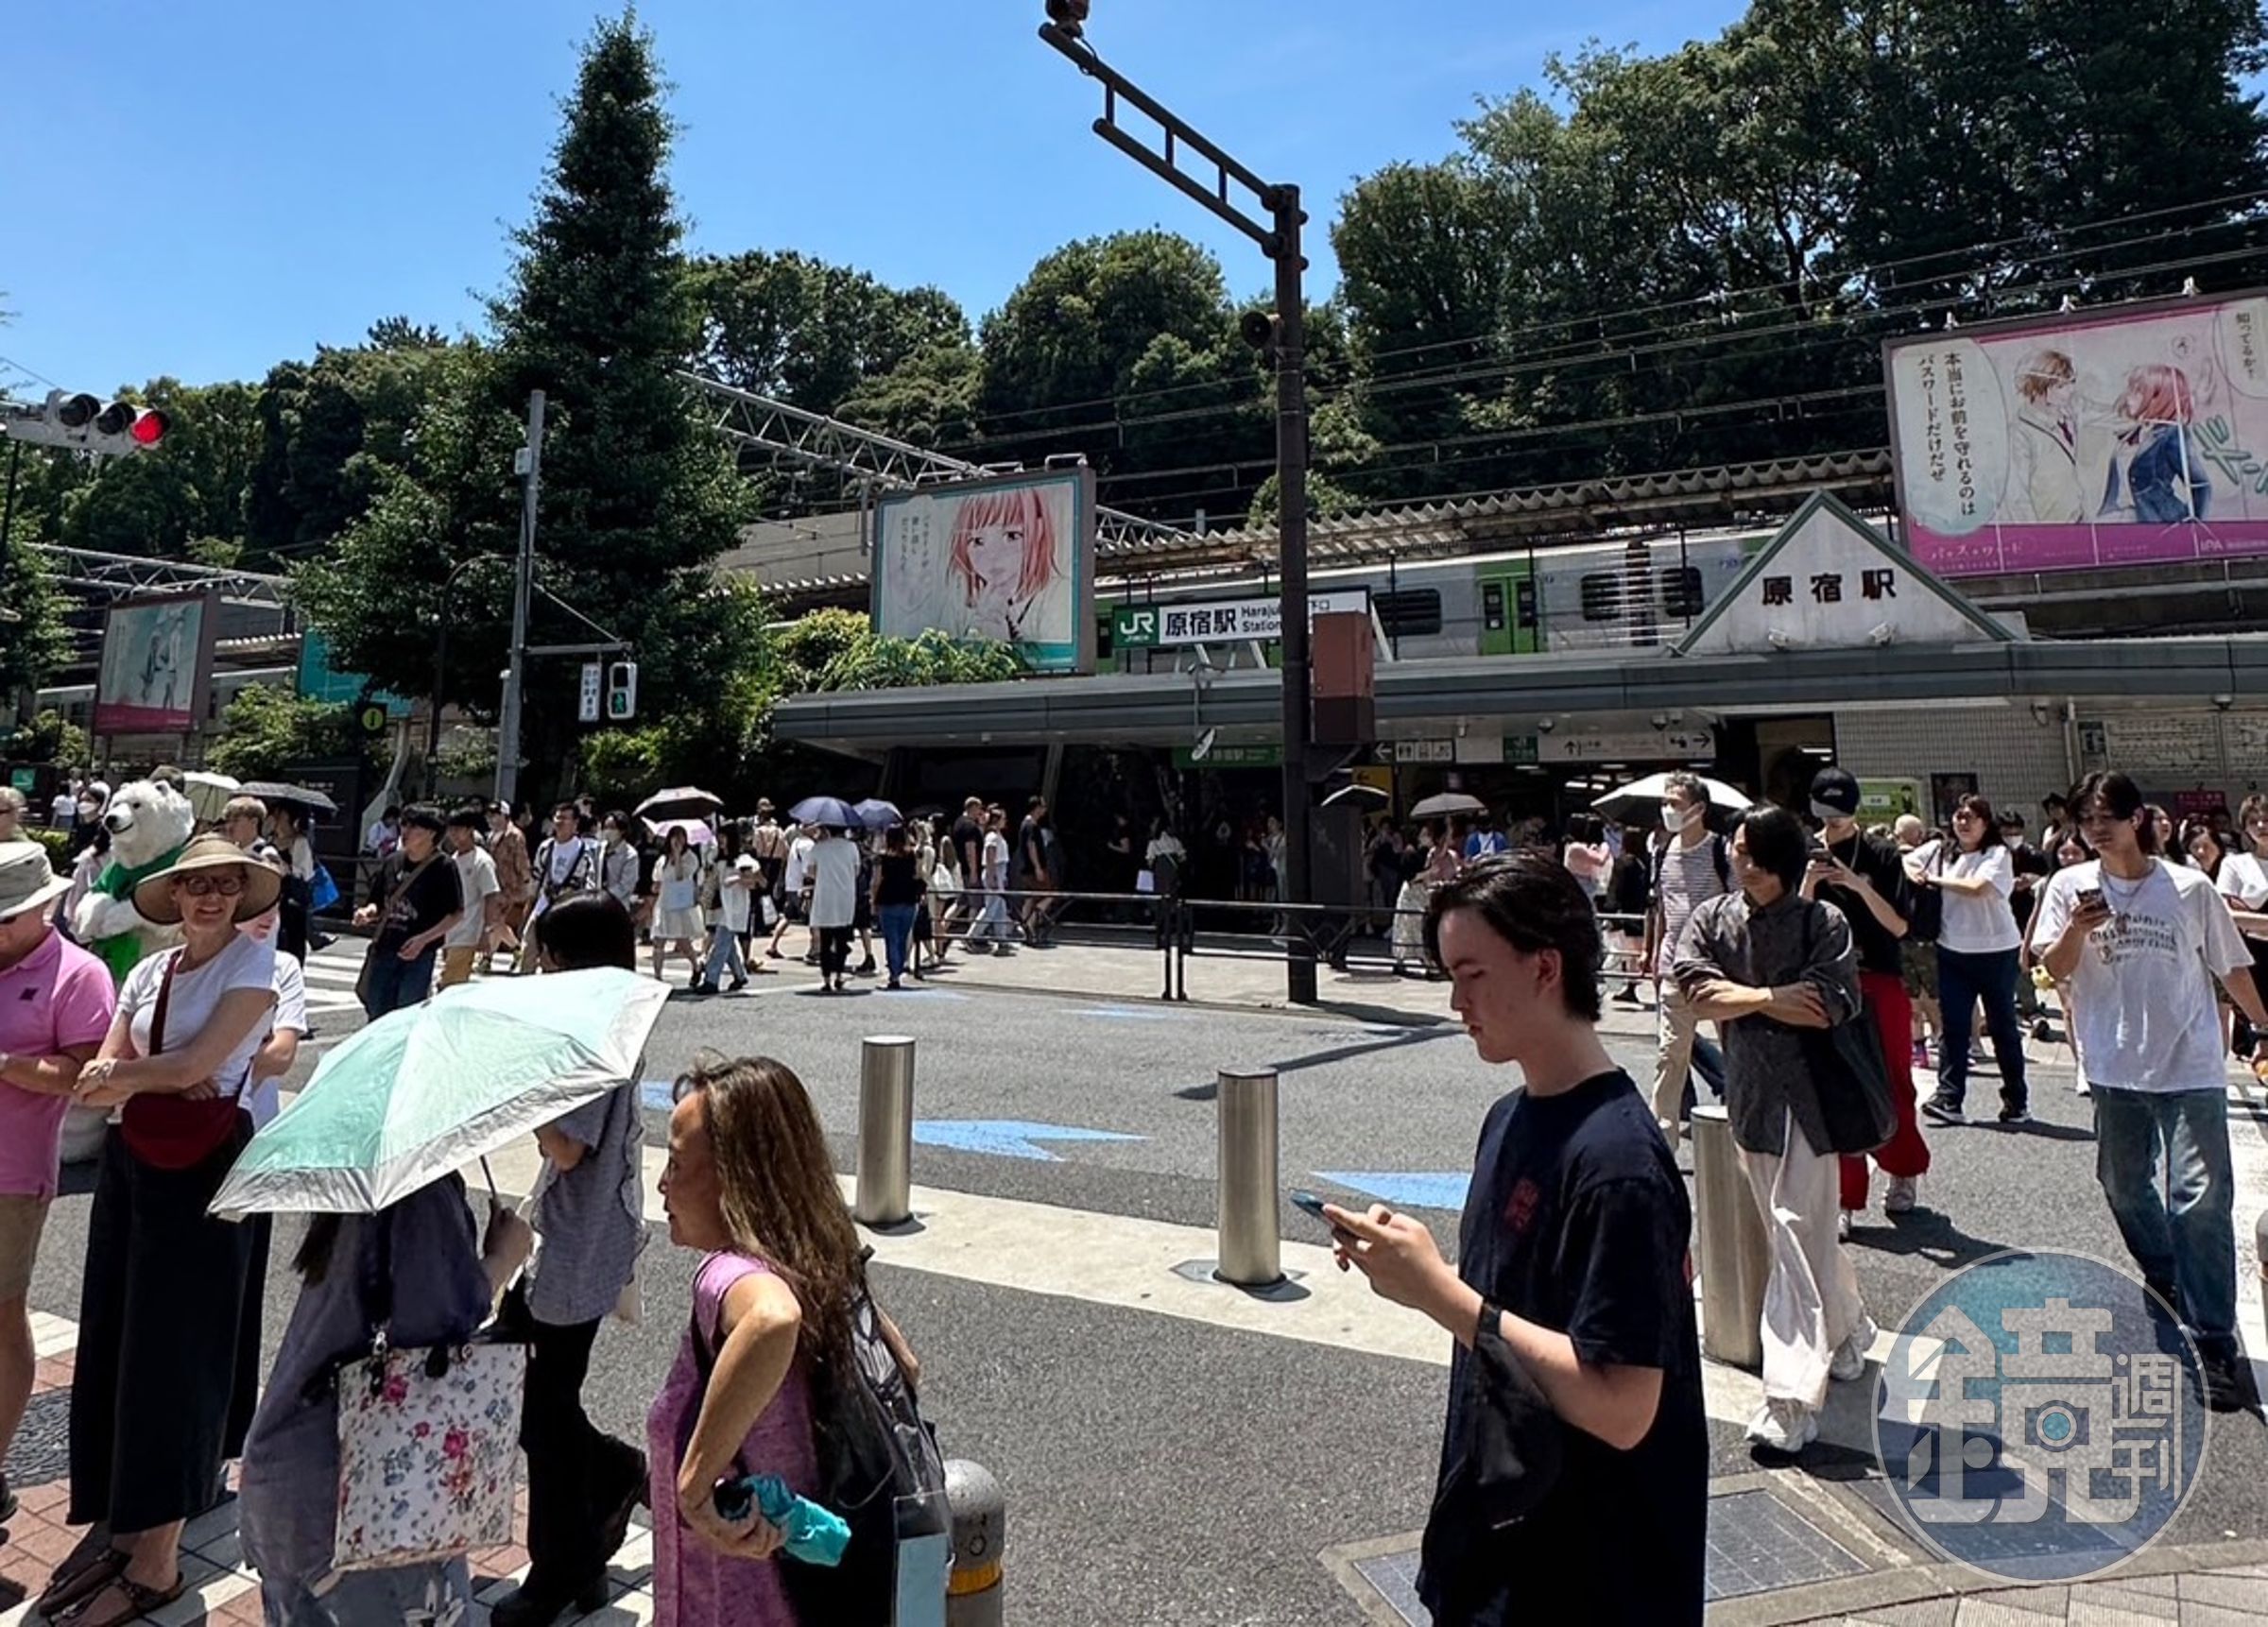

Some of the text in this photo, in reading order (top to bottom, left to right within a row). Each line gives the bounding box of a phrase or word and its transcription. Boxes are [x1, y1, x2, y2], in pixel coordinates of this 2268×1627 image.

[1918, 353, 1946, 482] パスワードだけだぜ
[1944, 352, 1976, 516] 本当にお前を守れるのは
[1761, 569, 1897, 606] 原宿駅
[1120, 612, 1154, 635] JR
[1165, 608, 1237, 637] 原宿駅
